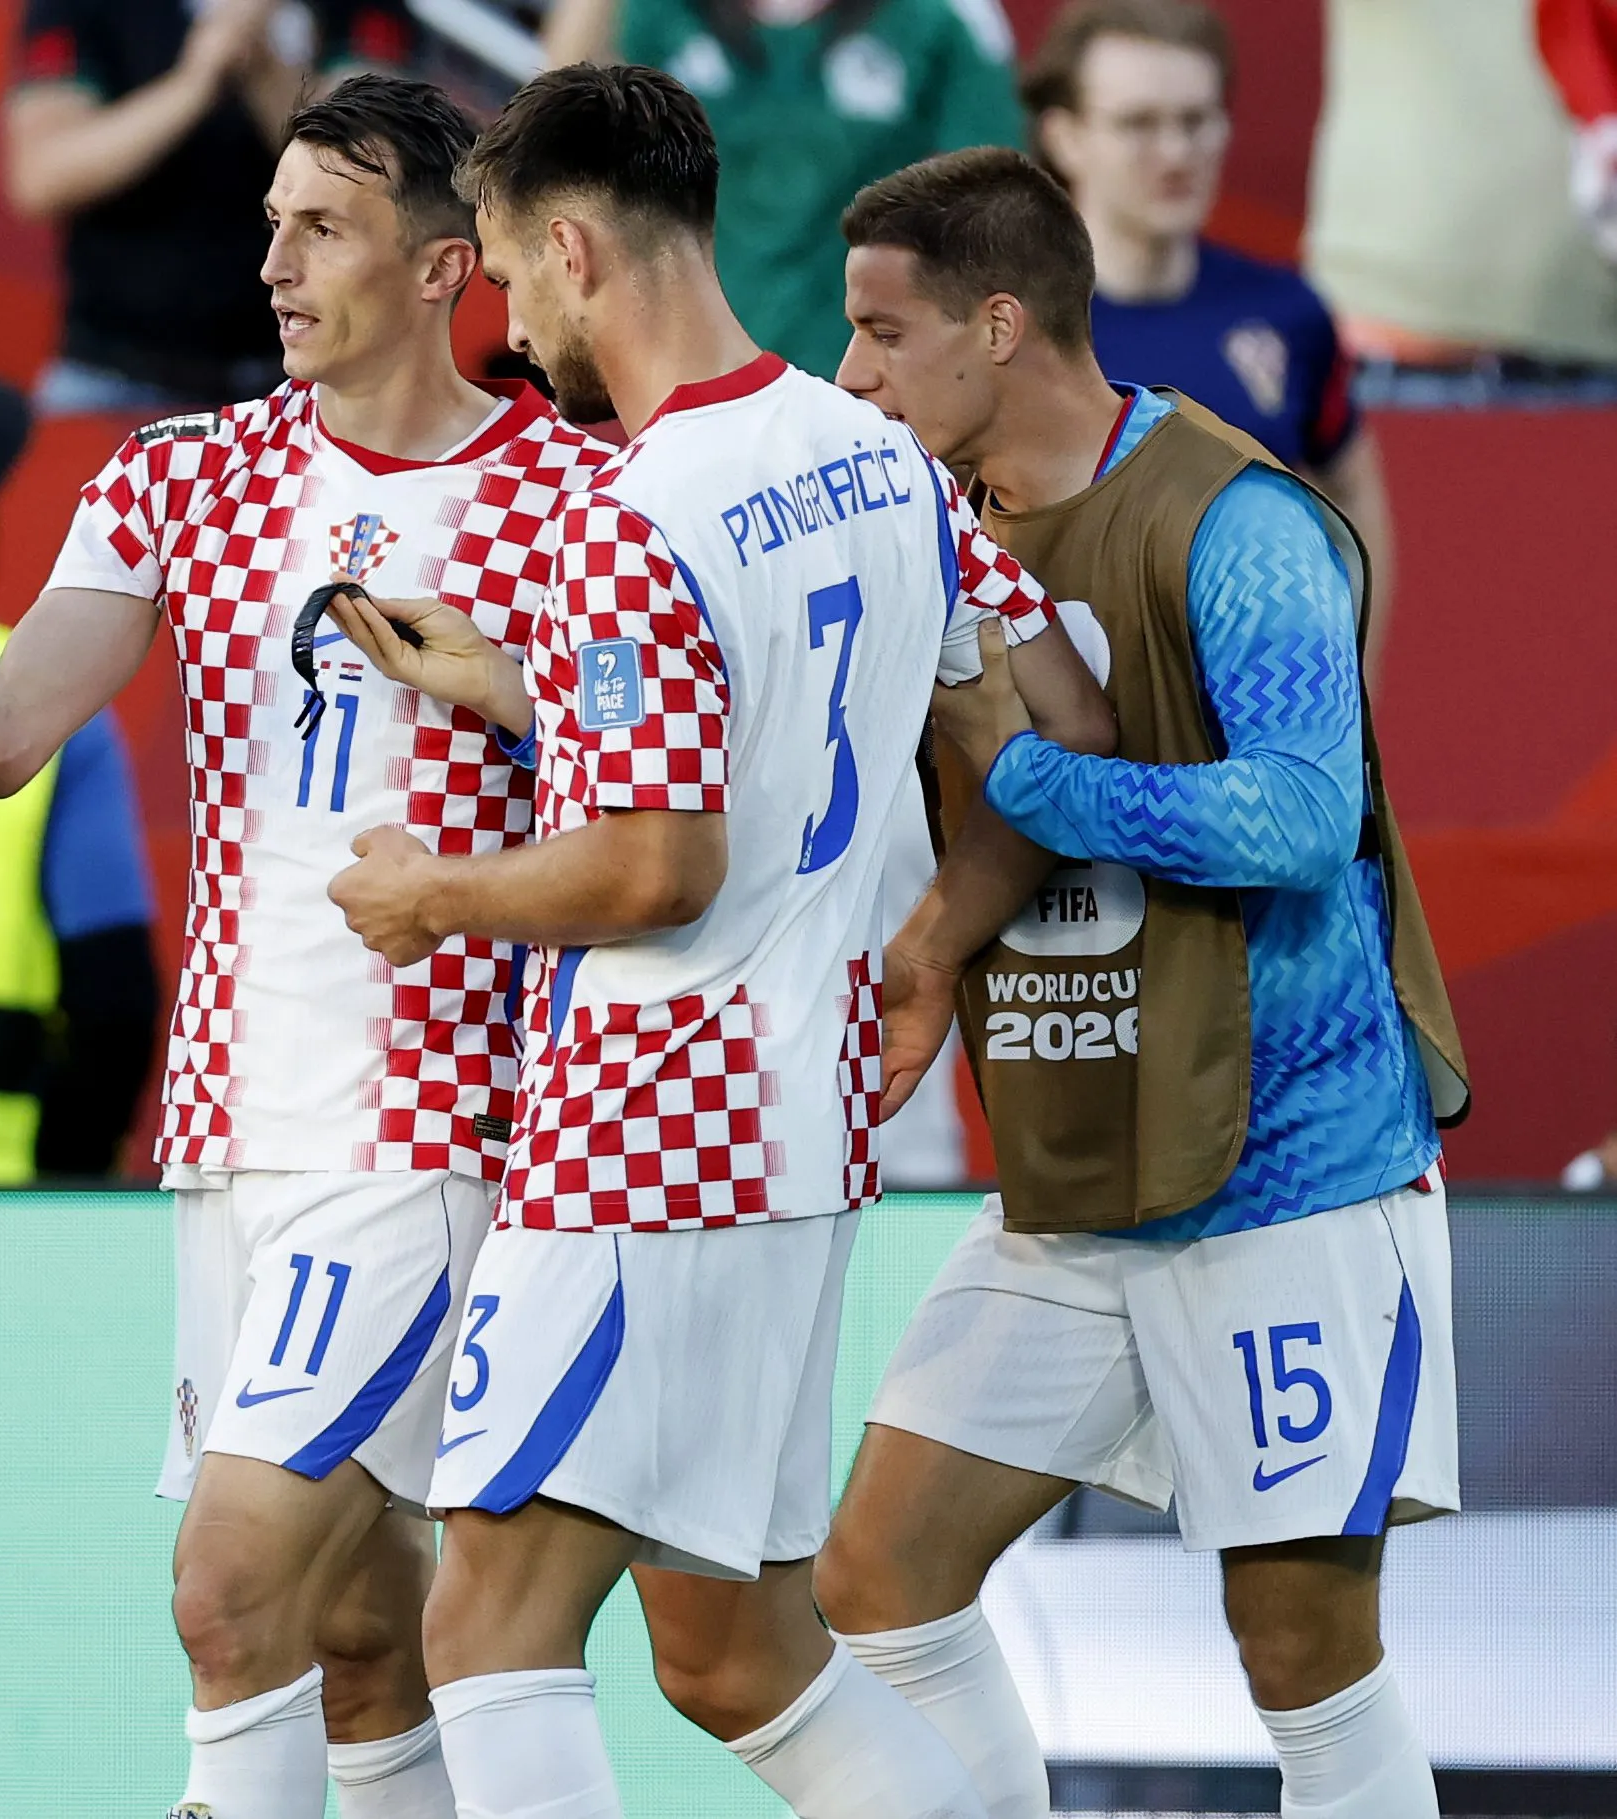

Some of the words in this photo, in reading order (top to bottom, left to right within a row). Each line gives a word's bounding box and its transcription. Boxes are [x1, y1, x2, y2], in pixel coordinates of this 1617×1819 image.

[296, 689, 359, 813] 11
[795, 575, 863, 875] 3
[1037, 886, 1099, 923] FIFA
[985, 972, 1089, 1003] WORLD
[1092, 968, 1141, 1002] CU
[269, 1253, 352, 1376] 11
[451, 1294, 500, 1412] 3
[1232, 1321, 1332, 1448] 15
